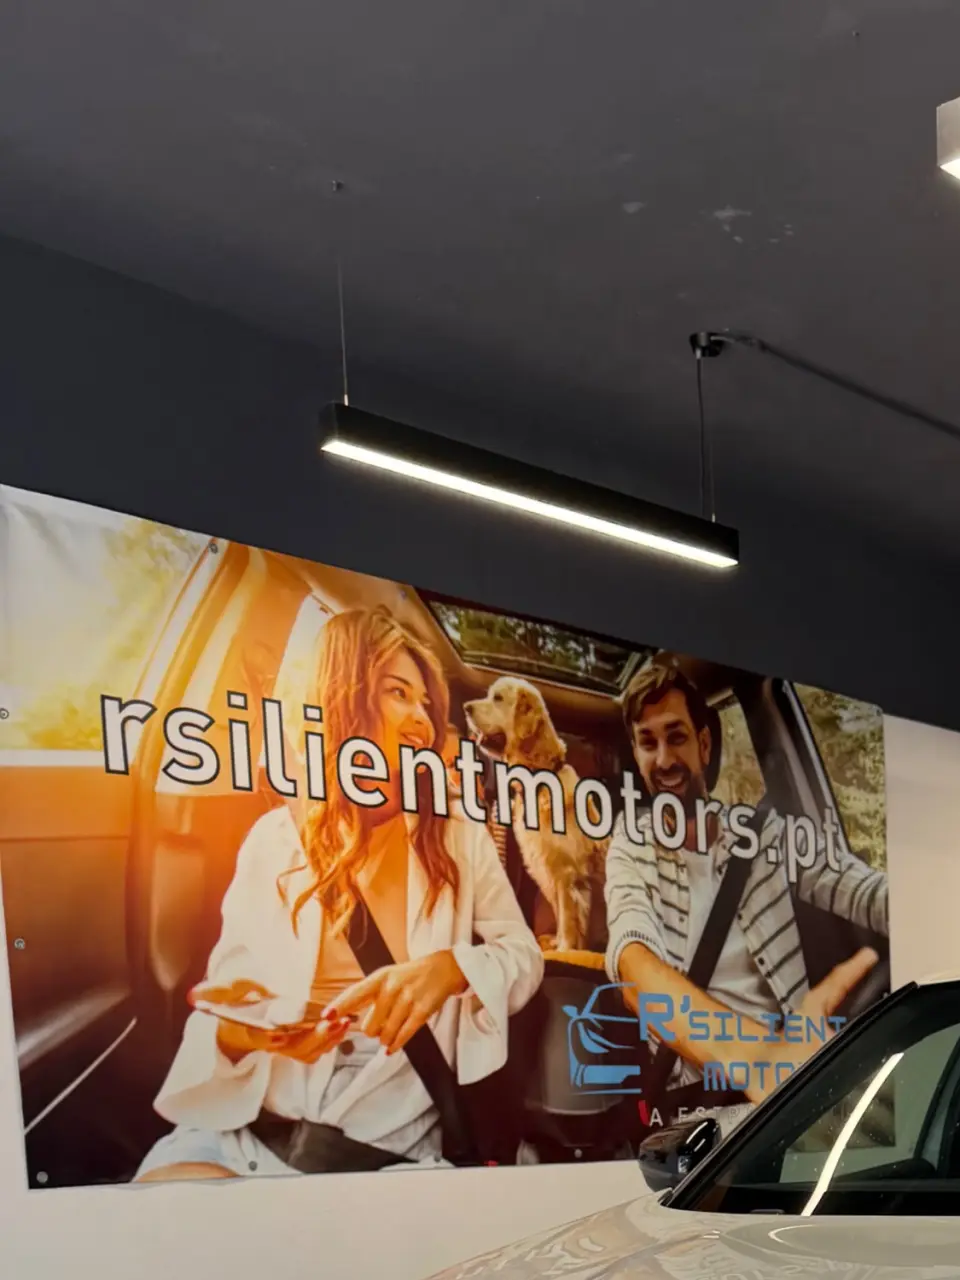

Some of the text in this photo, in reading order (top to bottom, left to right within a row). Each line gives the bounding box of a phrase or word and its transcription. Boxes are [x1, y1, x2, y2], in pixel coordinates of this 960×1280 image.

[101, 690, 841, 884] rsilientmotors.pt
[704, 1061, 799, 1091] MOTO
[649, 1107, 664, 1127] A
